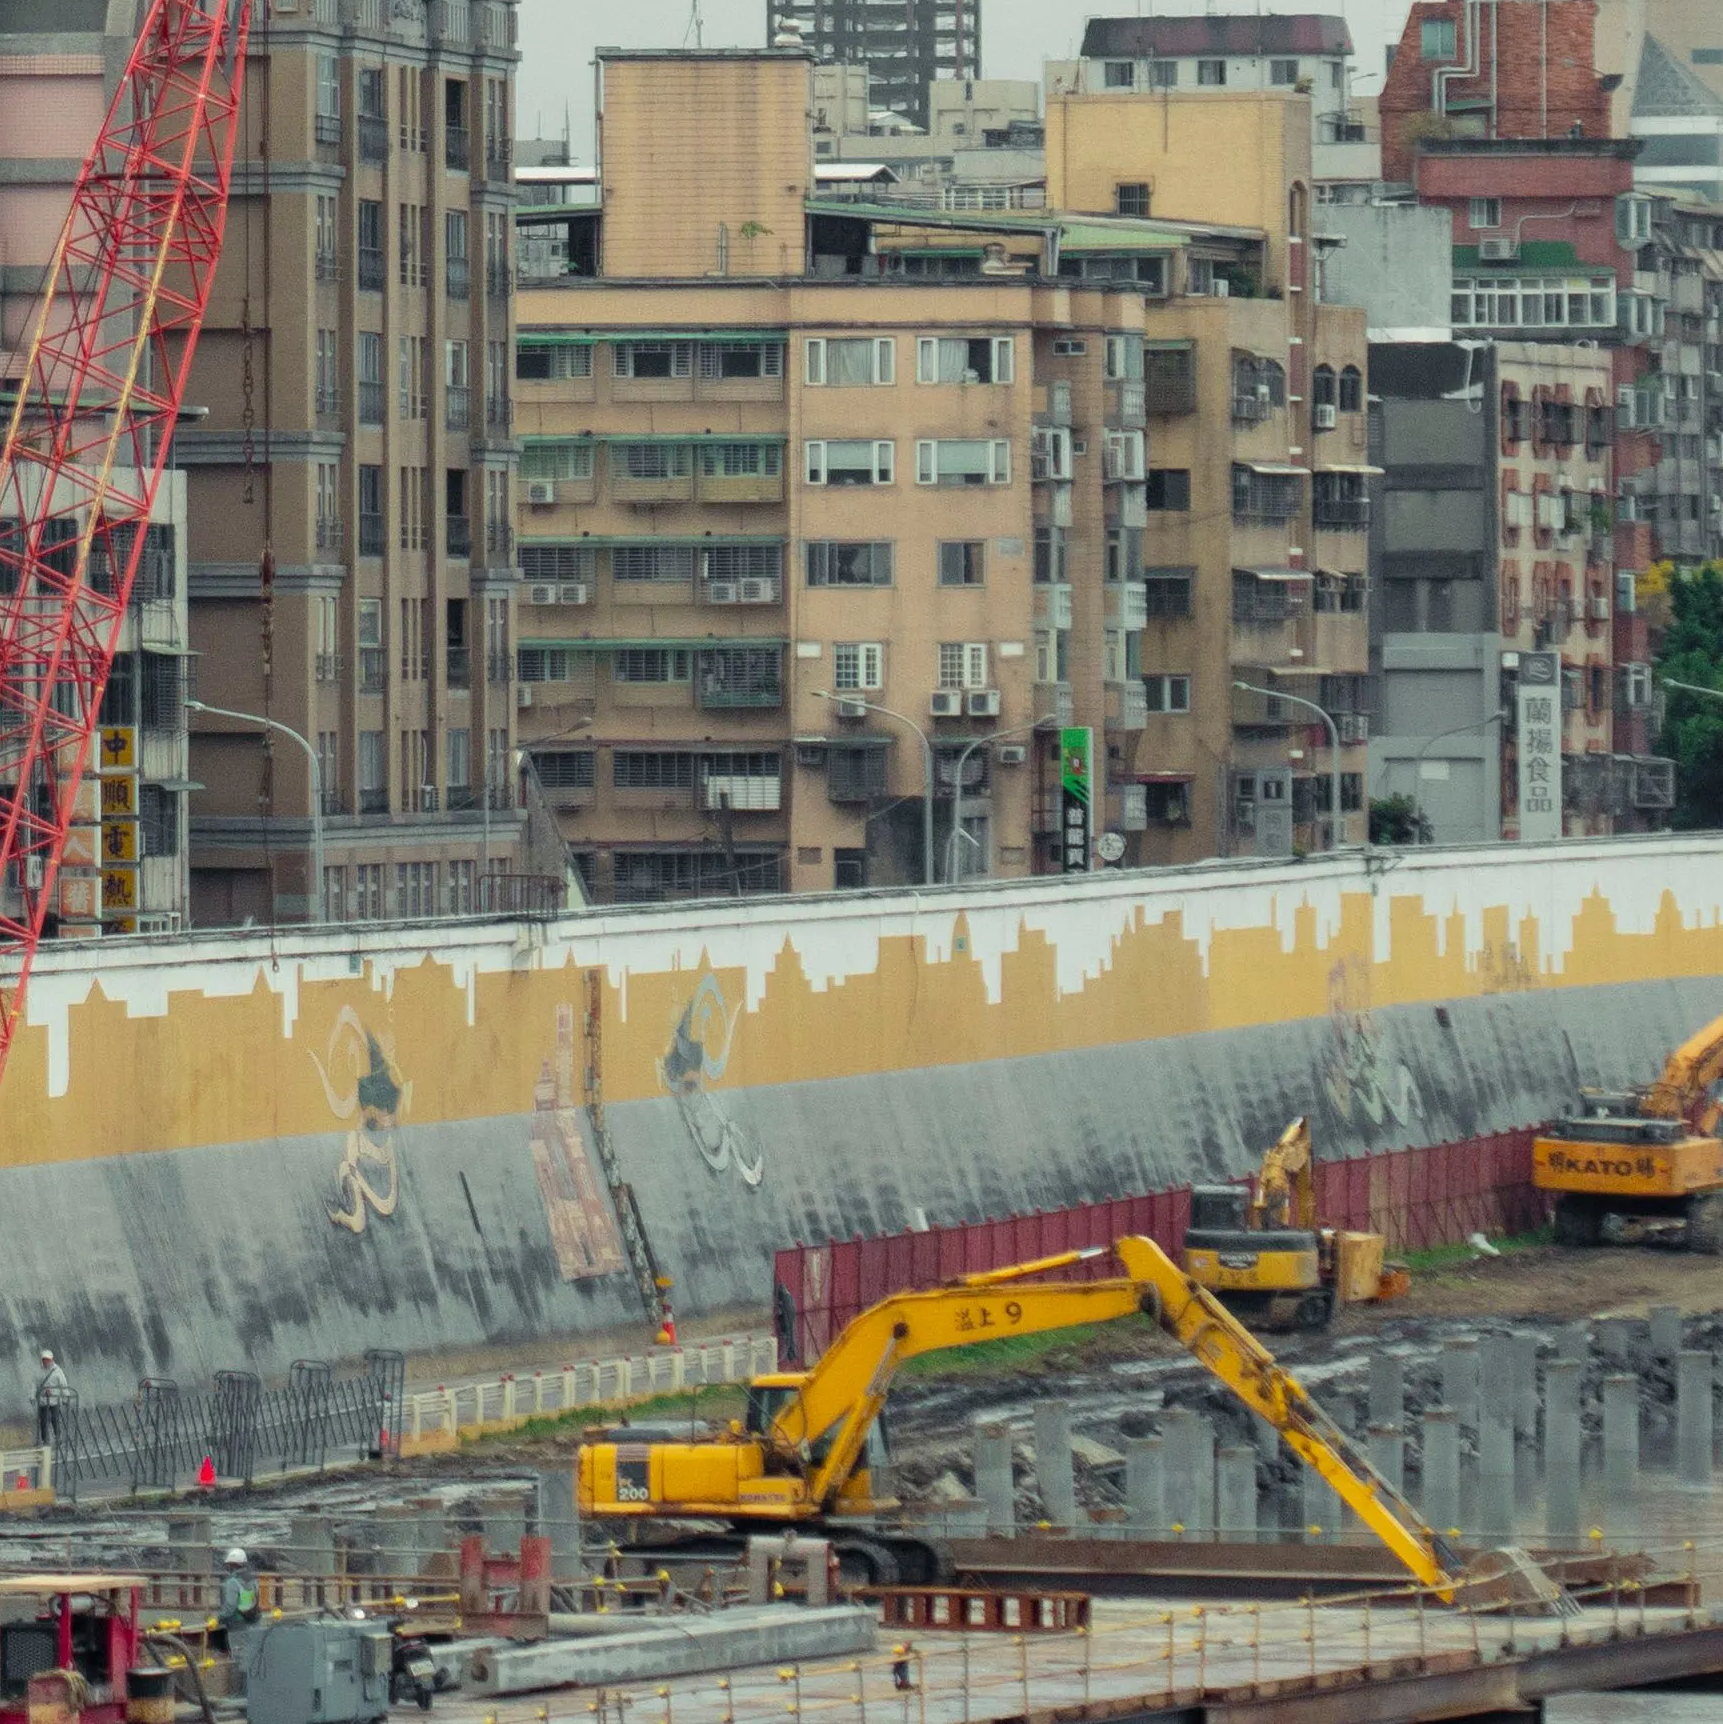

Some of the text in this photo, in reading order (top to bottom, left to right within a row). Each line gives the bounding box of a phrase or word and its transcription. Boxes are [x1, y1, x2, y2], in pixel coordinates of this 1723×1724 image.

[103, 728, 132, 932] 中順電熱
[1565, 1159, 1633, 1176] KATO
[1005, 1301, 1022, 1325] 9
[619, 1488, 649, 1501] 200
